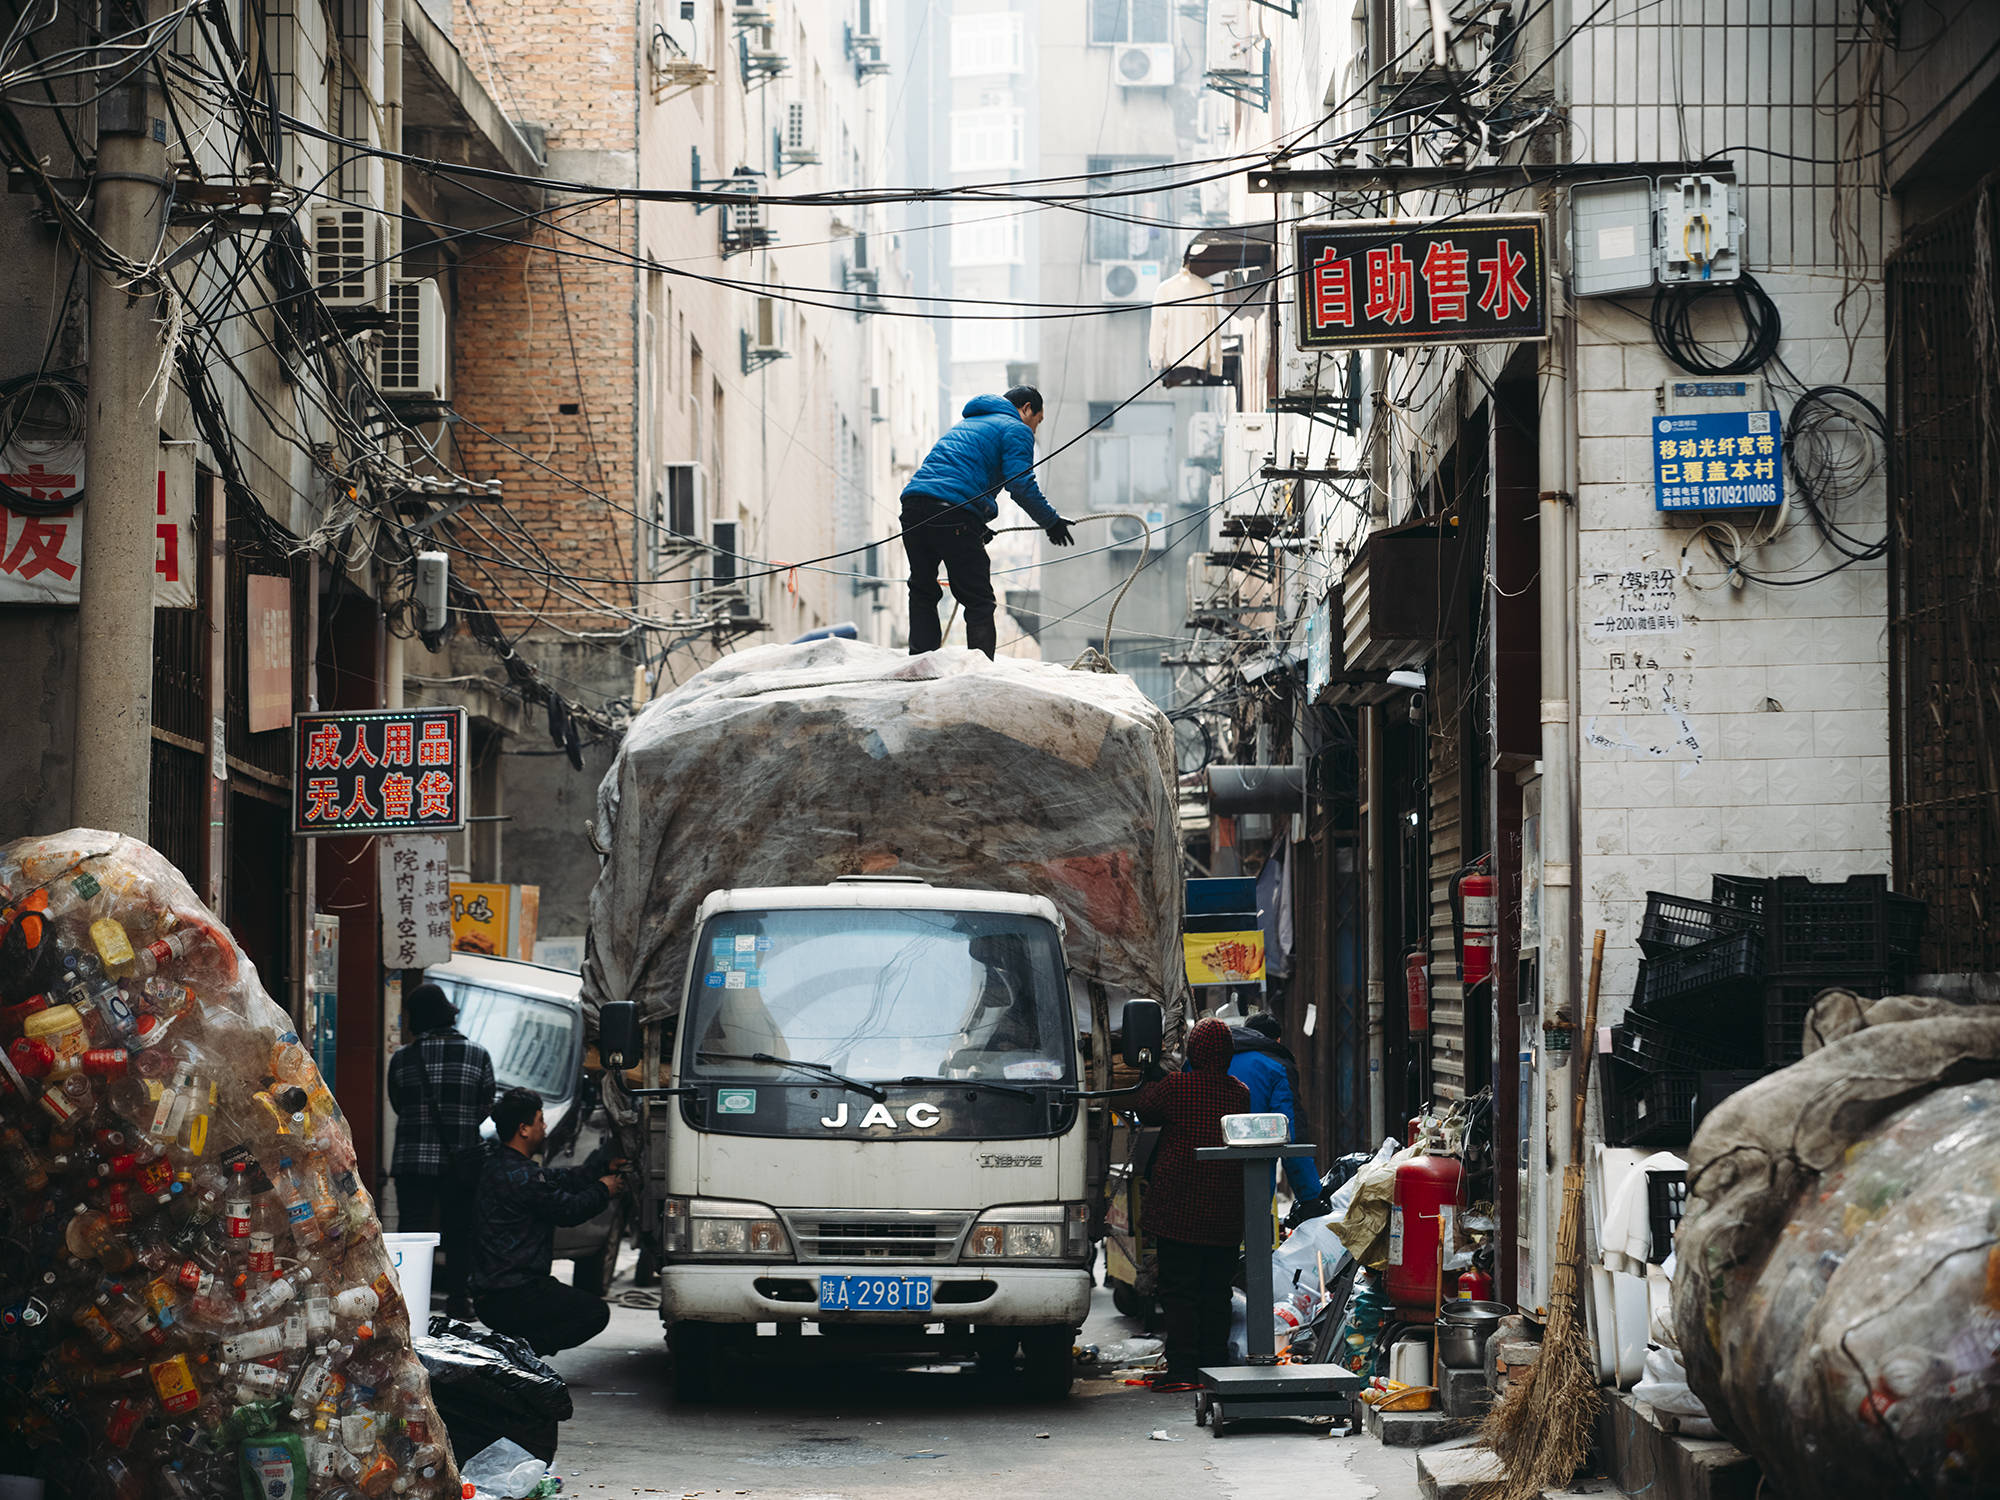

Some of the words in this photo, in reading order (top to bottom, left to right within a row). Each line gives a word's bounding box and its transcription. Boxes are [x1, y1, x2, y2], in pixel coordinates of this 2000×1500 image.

[1313, 238, 1531, 329] 自助售水
[1659, 435, 1775, 459] 移动光纤宽带
[1660, 458, 1775, 483] 已覆盖本村
[1662, 486, 1699, 497] 安装电话
[1702, 484, 1776, 505] 18709210086
[305, 720, 451, 770] 成人用品
[305, 771, 453, 821] 无人售货
[393, 848, 419, 965] 院内有空房
[820, 1103, 941, 1129] JAC
